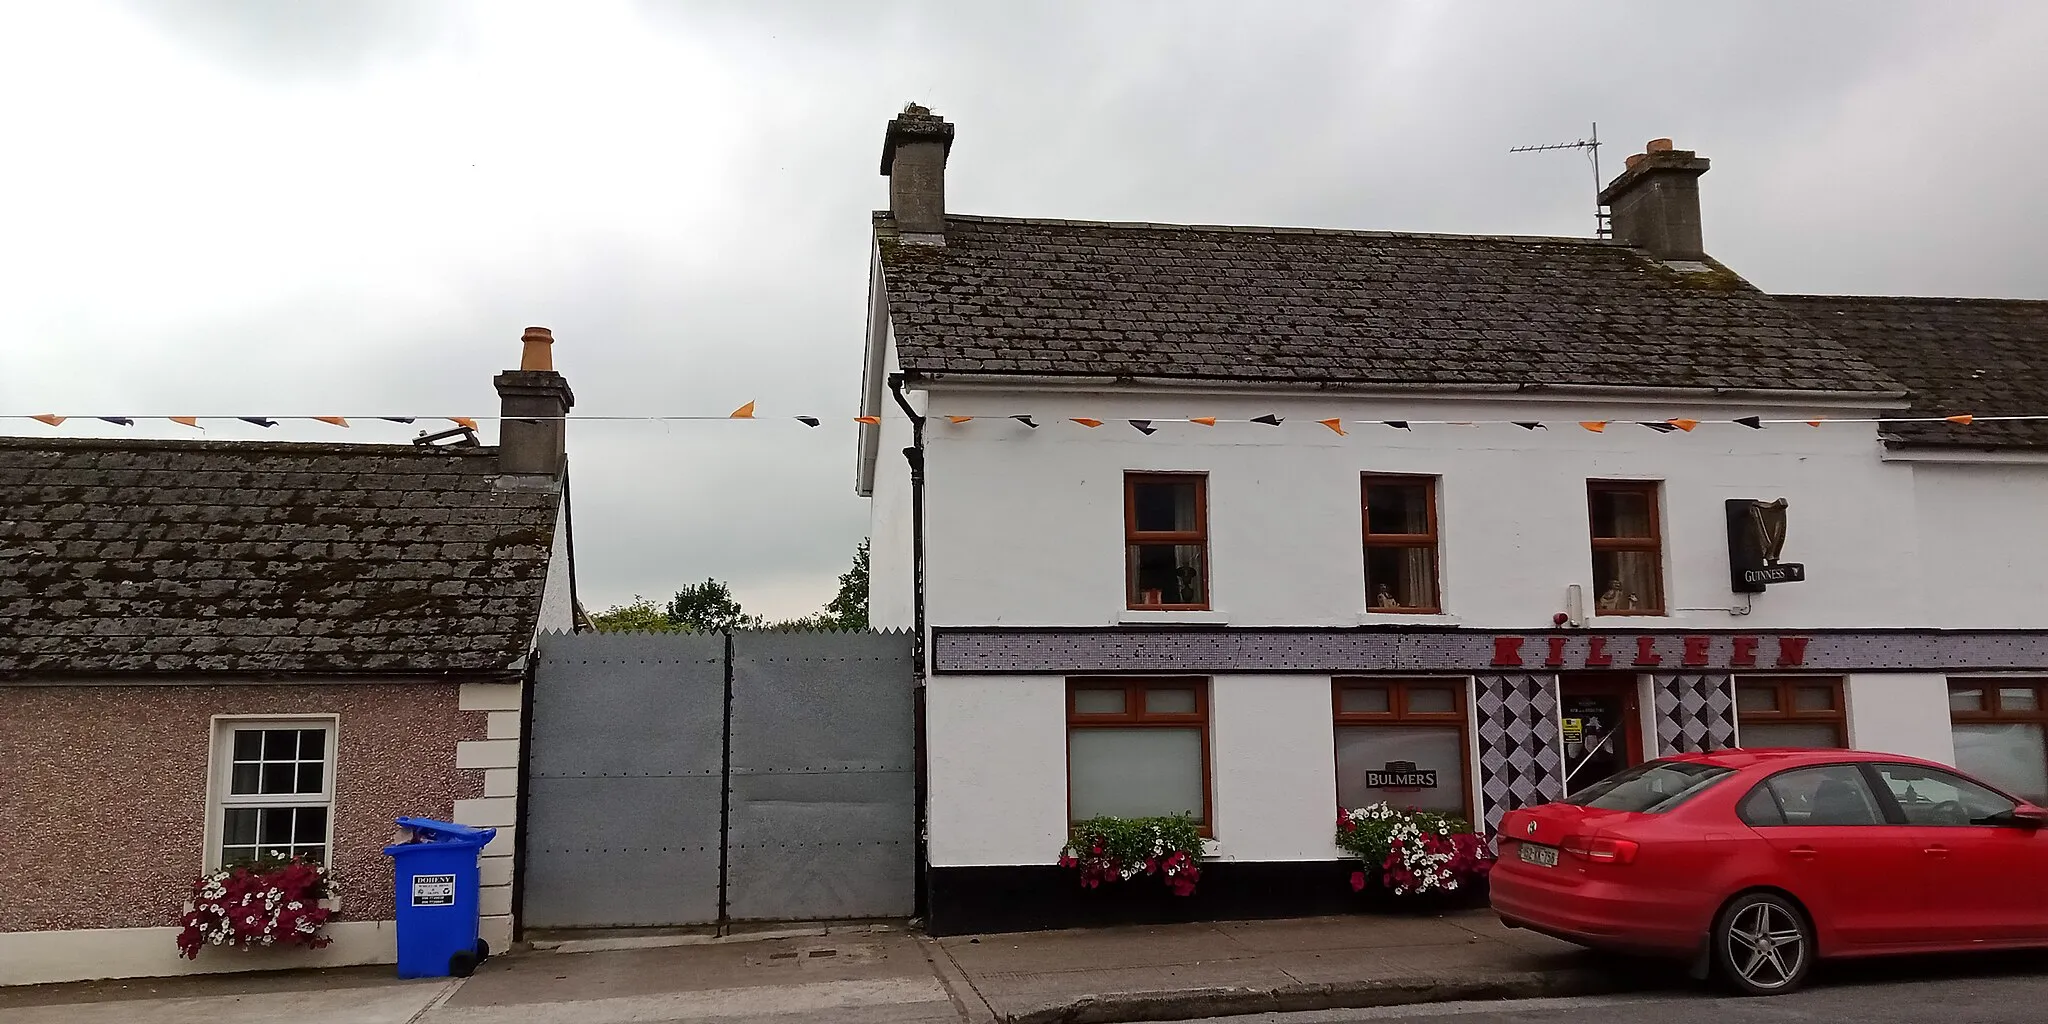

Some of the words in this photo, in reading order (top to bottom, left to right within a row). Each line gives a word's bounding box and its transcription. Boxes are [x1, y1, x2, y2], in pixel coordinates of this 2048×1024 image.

[1745, 568, 1785, 582] GUINNESS
[1492, 637, 1808, 666] KILLEEN
[1368, 773, 1435, 786] BULMERS
